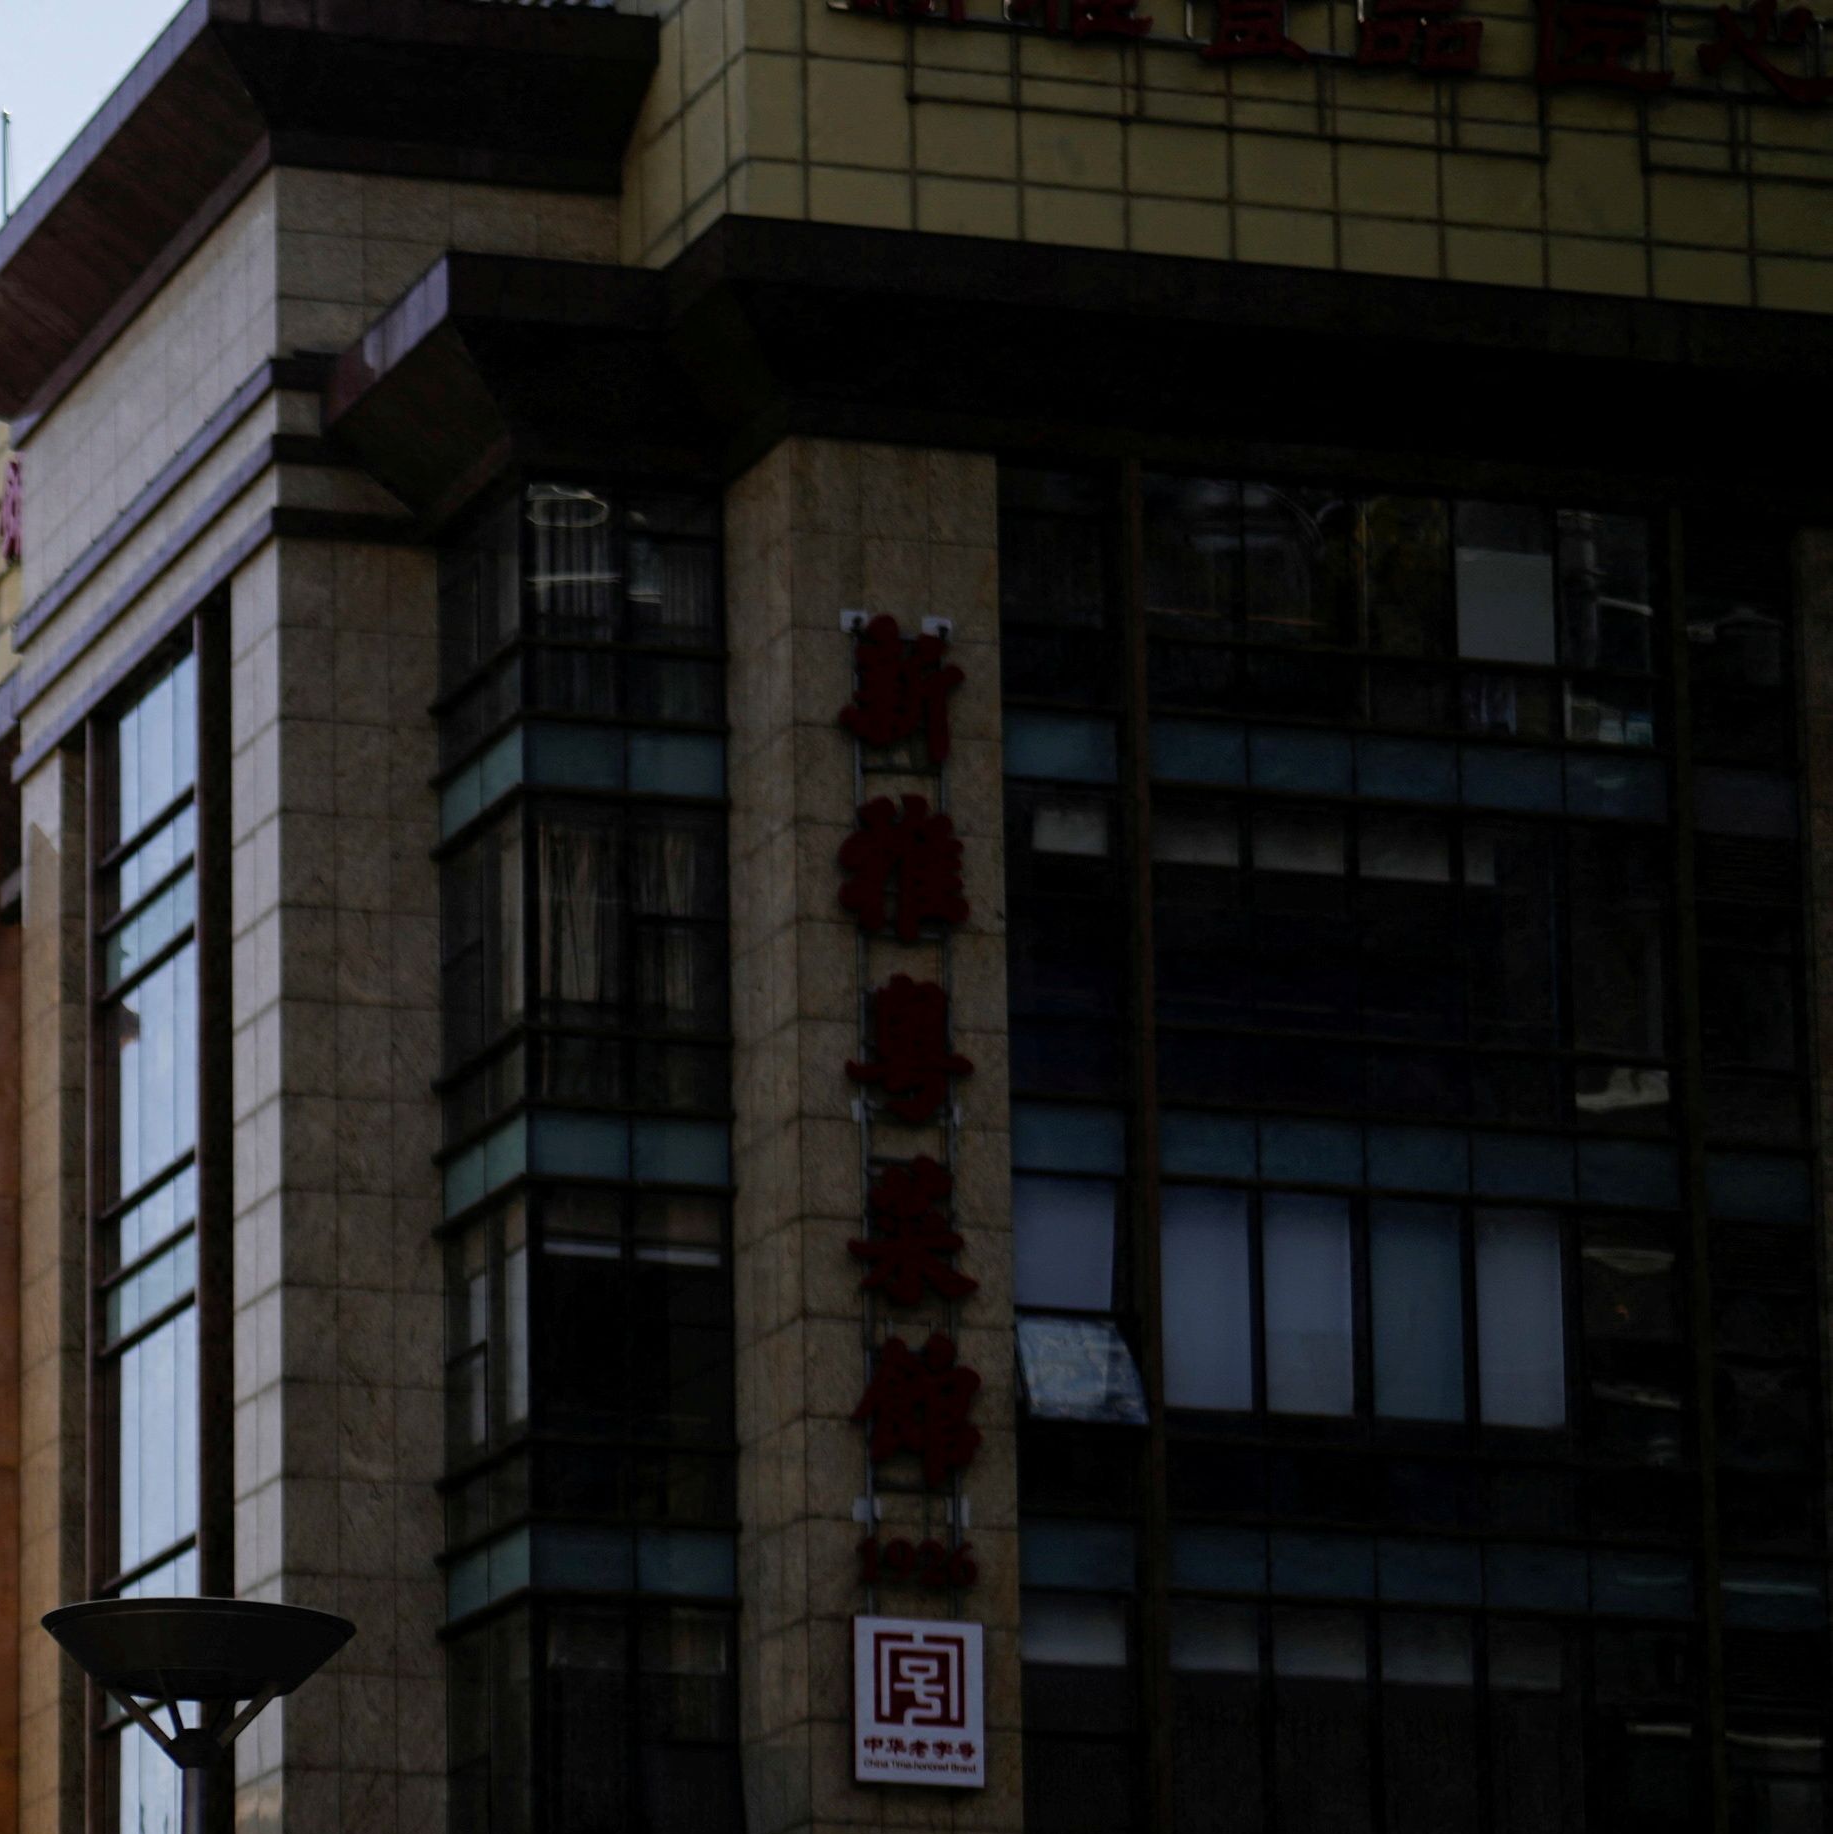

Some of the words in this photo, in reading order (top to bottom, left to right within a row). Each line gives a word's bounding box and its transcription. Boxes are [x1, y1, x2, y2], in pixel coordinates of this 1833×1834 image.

[857, 1536, 976, 1588] 1926
[863, 1735, 976, 1761] 中华老字号
